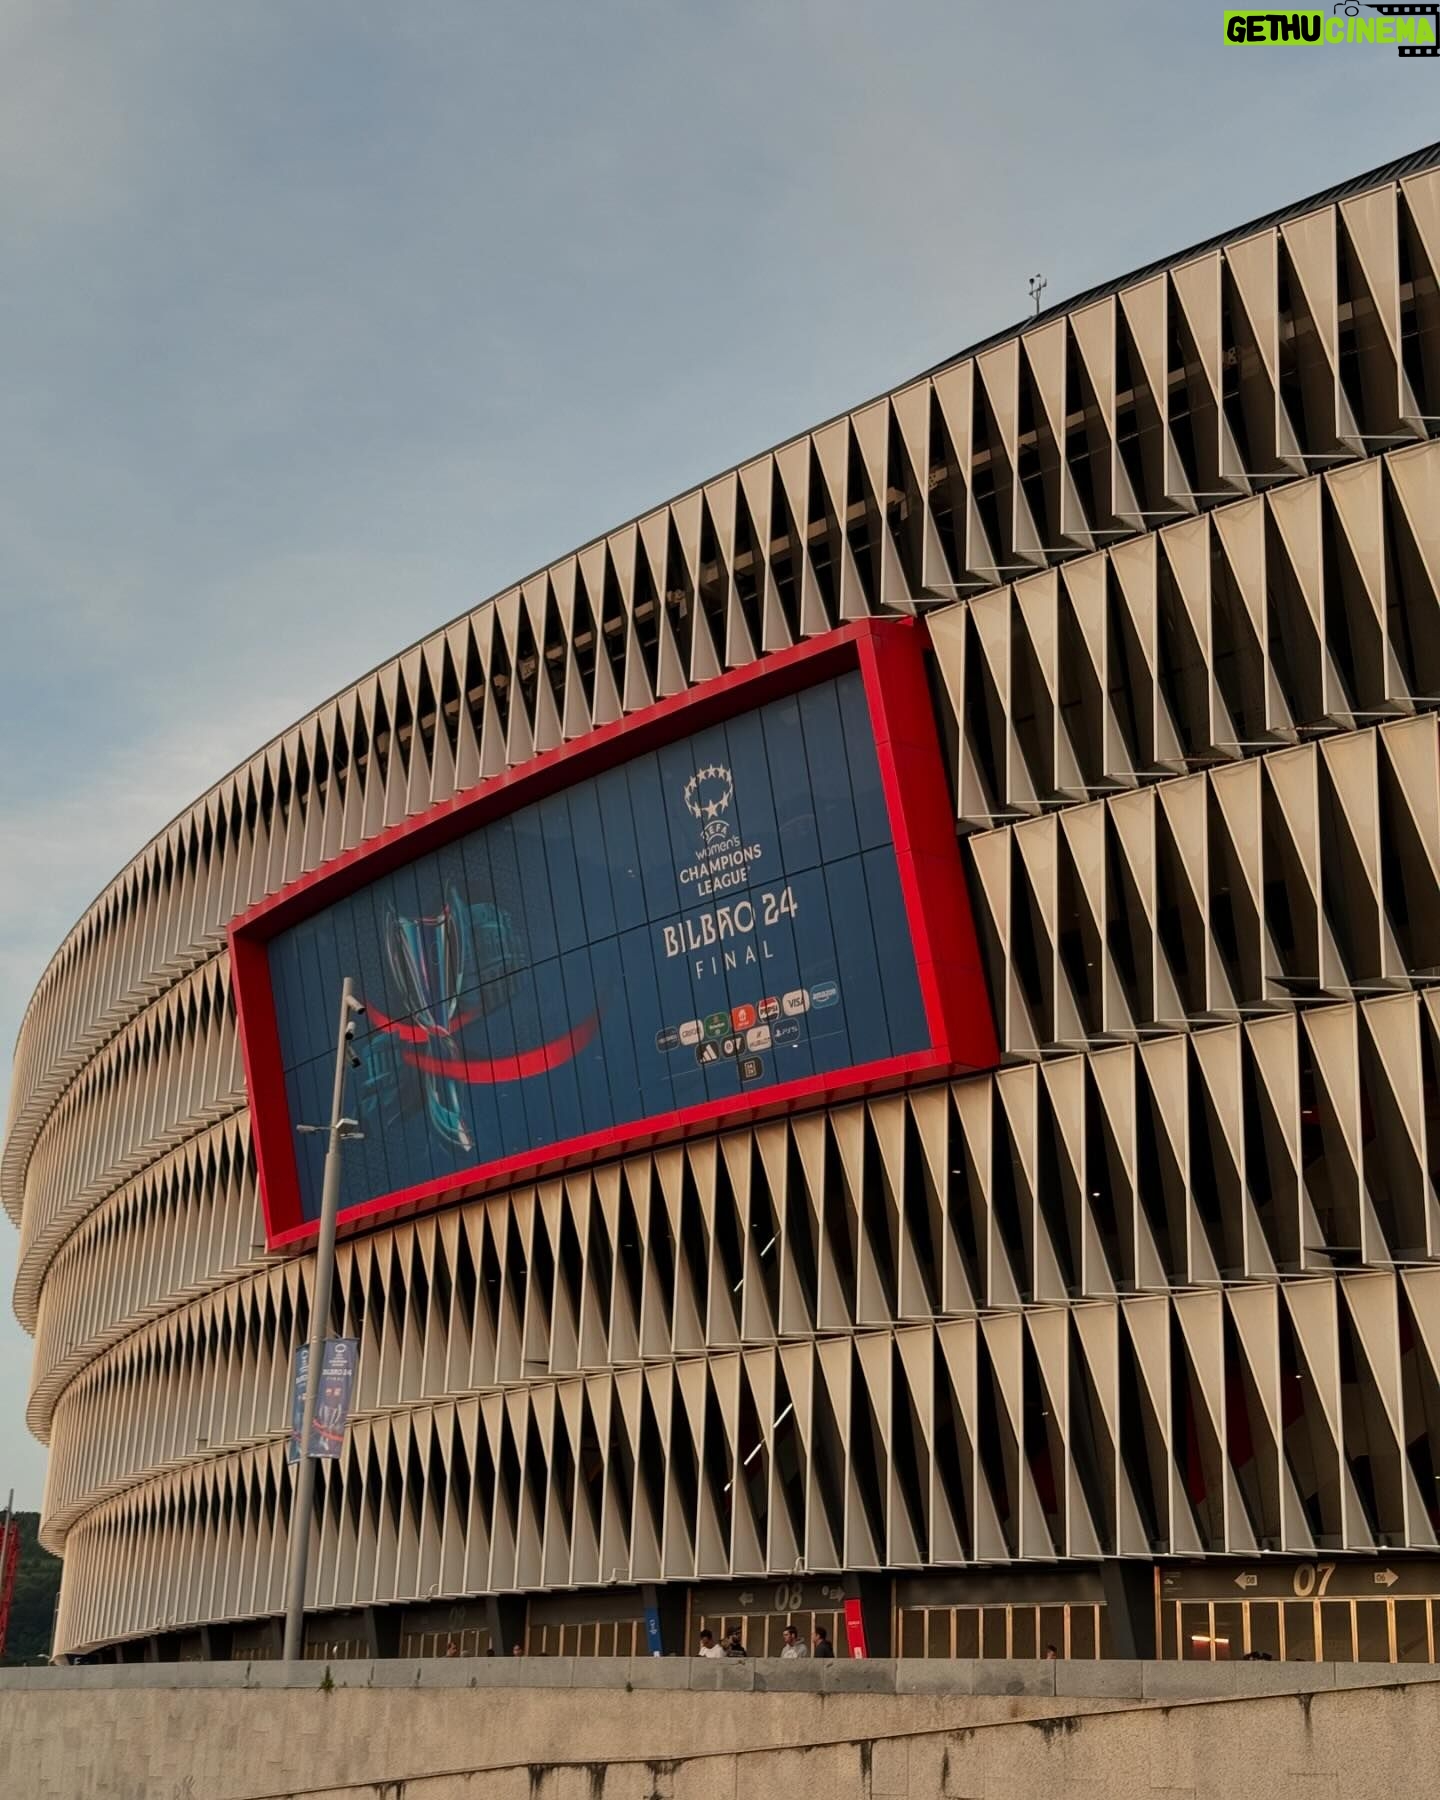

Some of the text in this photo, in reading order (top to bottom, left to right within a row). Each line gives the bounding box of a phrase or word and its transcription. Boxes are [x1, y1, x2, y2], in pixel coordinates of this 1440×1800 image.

[679, 844, 762, 884] CHAMPIONS
[695, 835, 742, 861] women's
[697, 869, 748, 897] LEAGUE
[663, 886, 798, 958] BILBAO 24
[695, 940, 774, 979] FINAL
[1293, 1563, 1336, 1596] 07
[774, 1583, 803, 1610] 08
